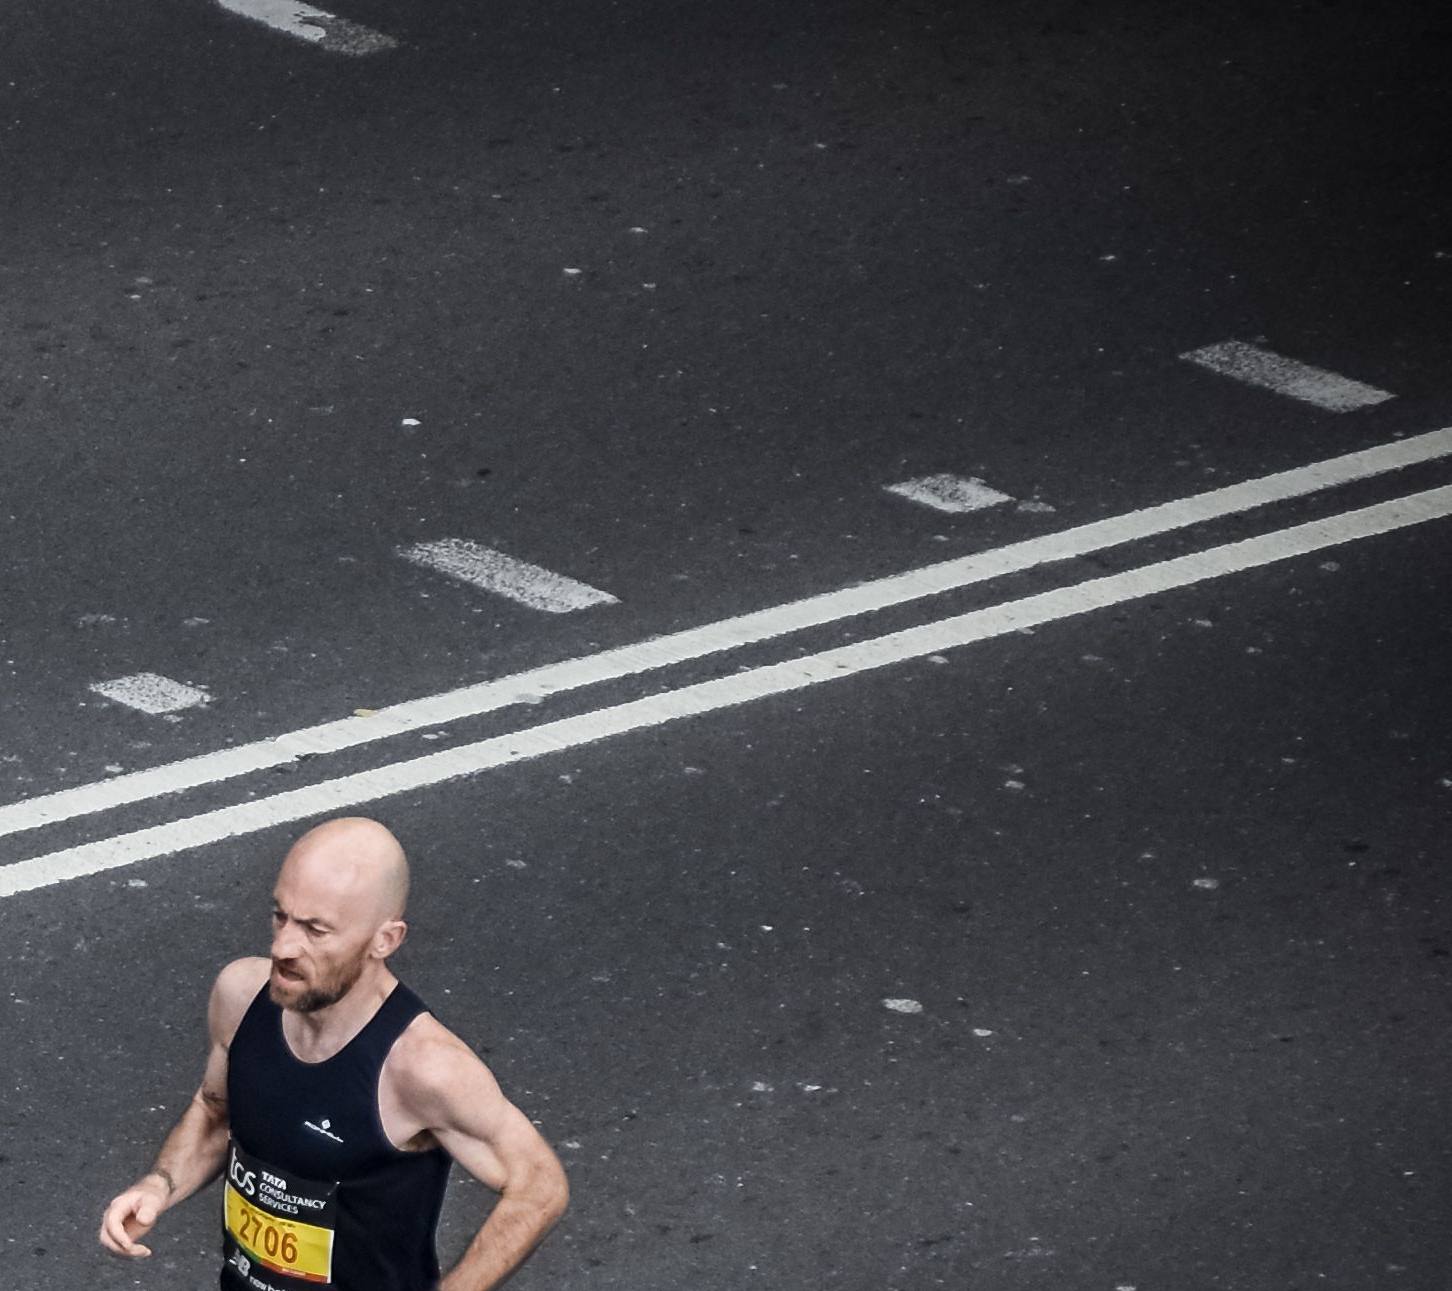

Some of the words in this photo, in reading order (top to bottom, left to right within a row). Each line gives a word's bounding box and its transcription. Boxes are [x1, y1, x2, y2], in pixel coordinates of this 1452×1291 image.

[261, 1171, 287, 1191] TATA
[259, 1182, 327, 1210] CONSULTANCY
[259, 1193, 299, 1215] SERVICES
[238, 1208, 298, 1264] 2706
[249, 1275, 267, 1291] new
